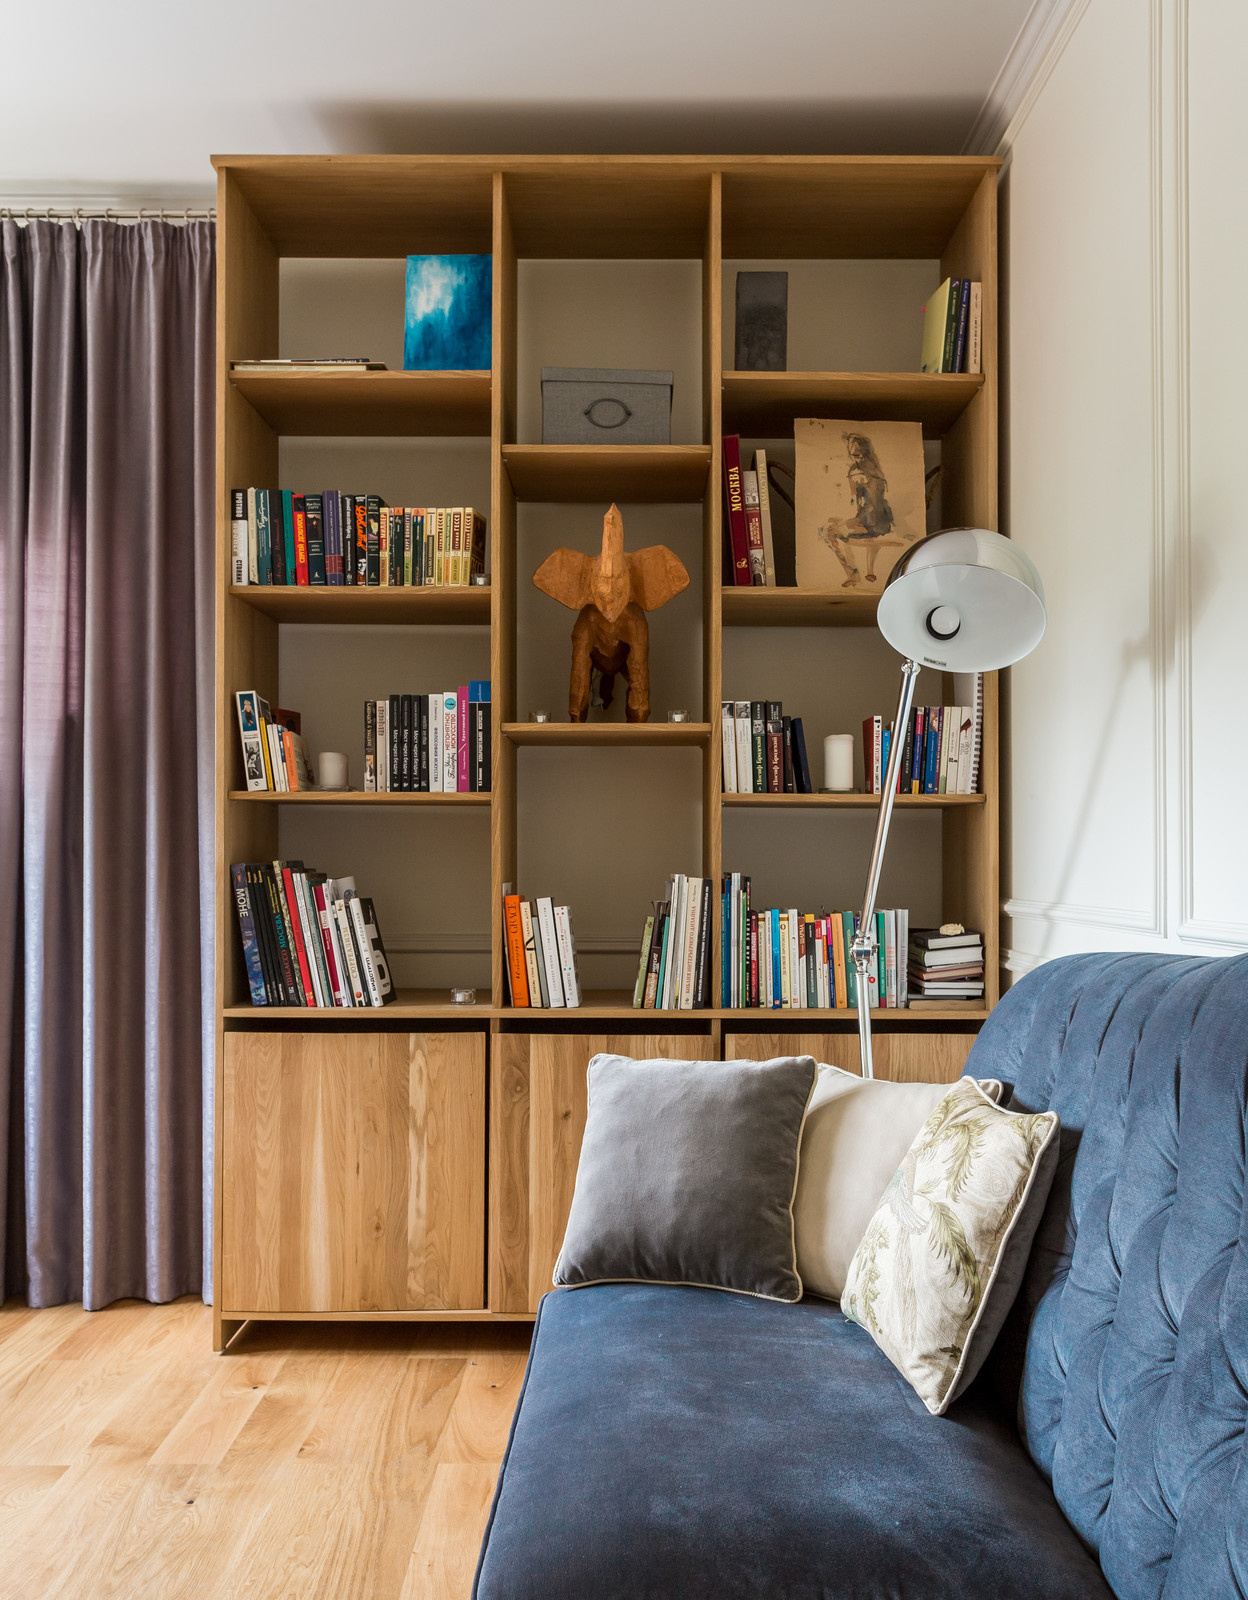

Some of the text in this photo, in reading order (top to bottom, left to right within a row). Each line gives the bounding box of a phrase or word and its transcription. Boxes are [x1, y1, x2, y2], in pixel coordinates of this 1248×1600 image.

[728, 466, 742, 511] МОСКВА
[759, 463, 769, 510] КАМАСУТРА
[297, 513, 305, 564] СЕРГЕЙ ДОВЛАТОВ
[236, 888, 248, 918] МОНЕ
[321, 911, 329, 928] Orsay
[507, 901, 518, 934] GRACE
[275, 914, 293, 986] ПИКАССО МОСКВА
[343, 926, 358, 979] СЮРРЕАЛИЗМ
[355, 912, 377, 991] БИДСТРУП избранное
[686, 932, 695, 973] ИНТЕРЬЕРНОГО
